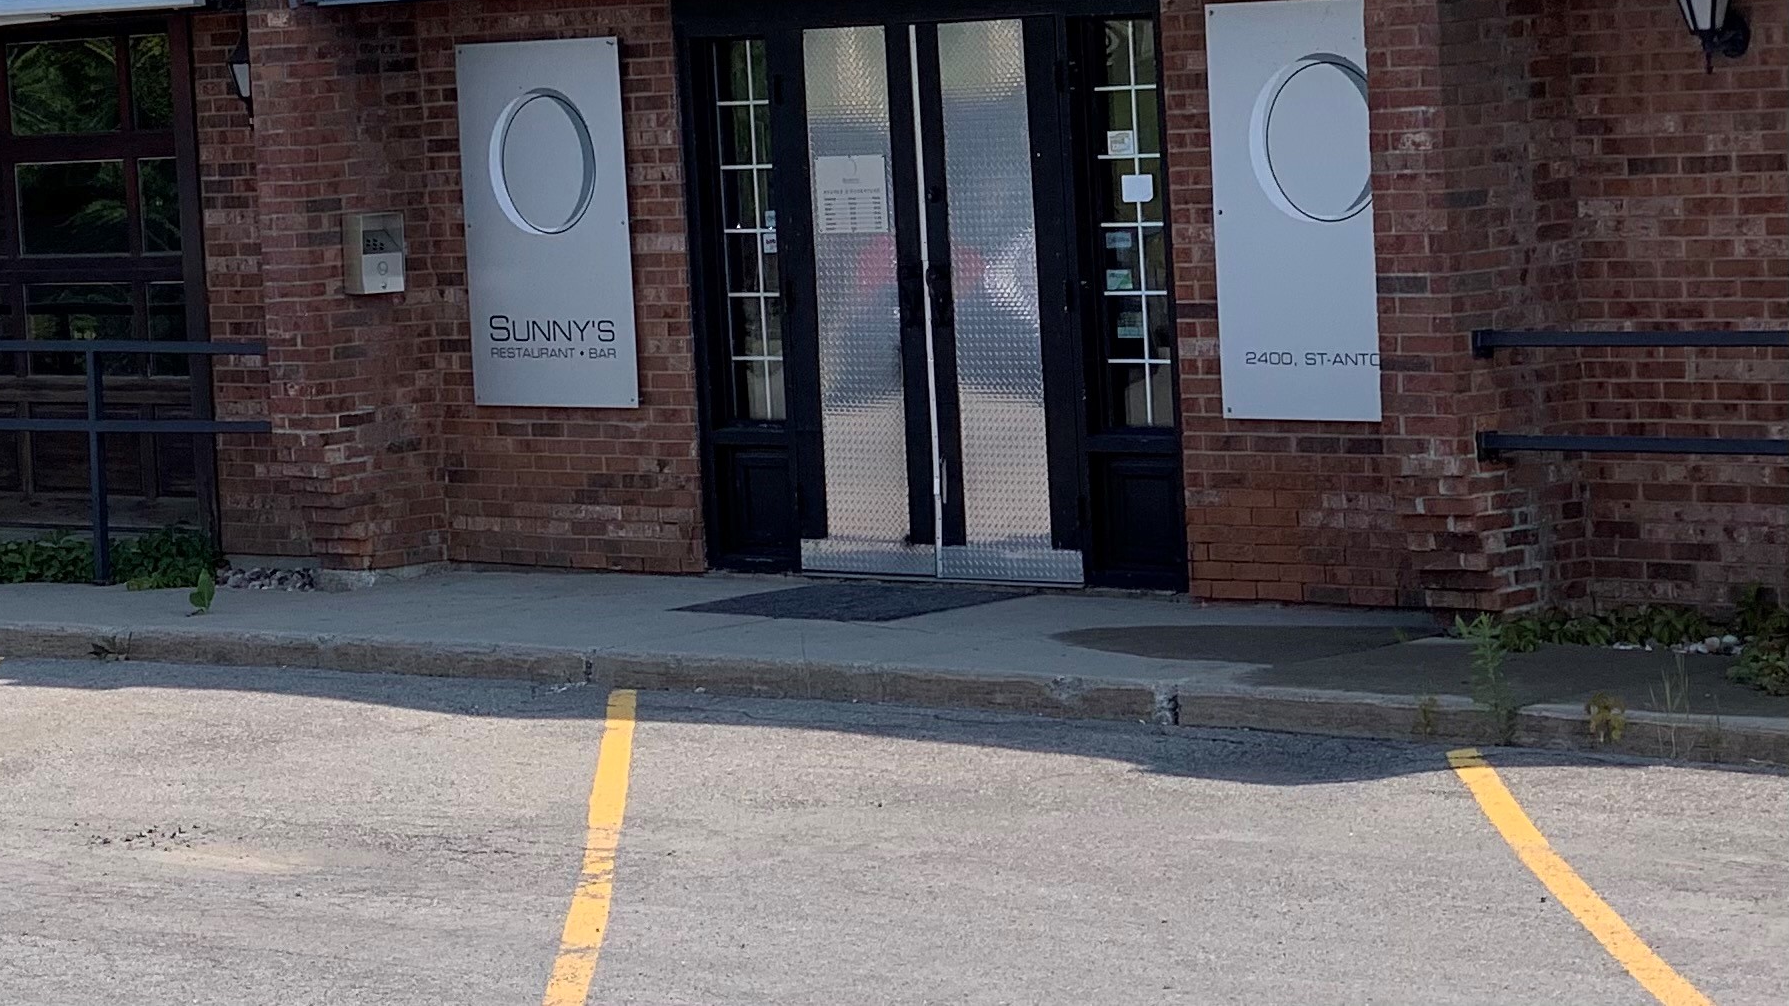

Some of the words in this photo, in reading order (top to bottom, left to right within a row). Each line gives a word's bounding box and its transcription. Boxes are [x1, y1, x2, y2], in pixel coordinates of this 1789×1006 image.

[489, 314, 615, 342] SUNNY'S
[490, 347, 575, 359] RESTAURANT
[588, 347, 617, 359] BAR
[1245, 351, 1298, 367] 2400,
